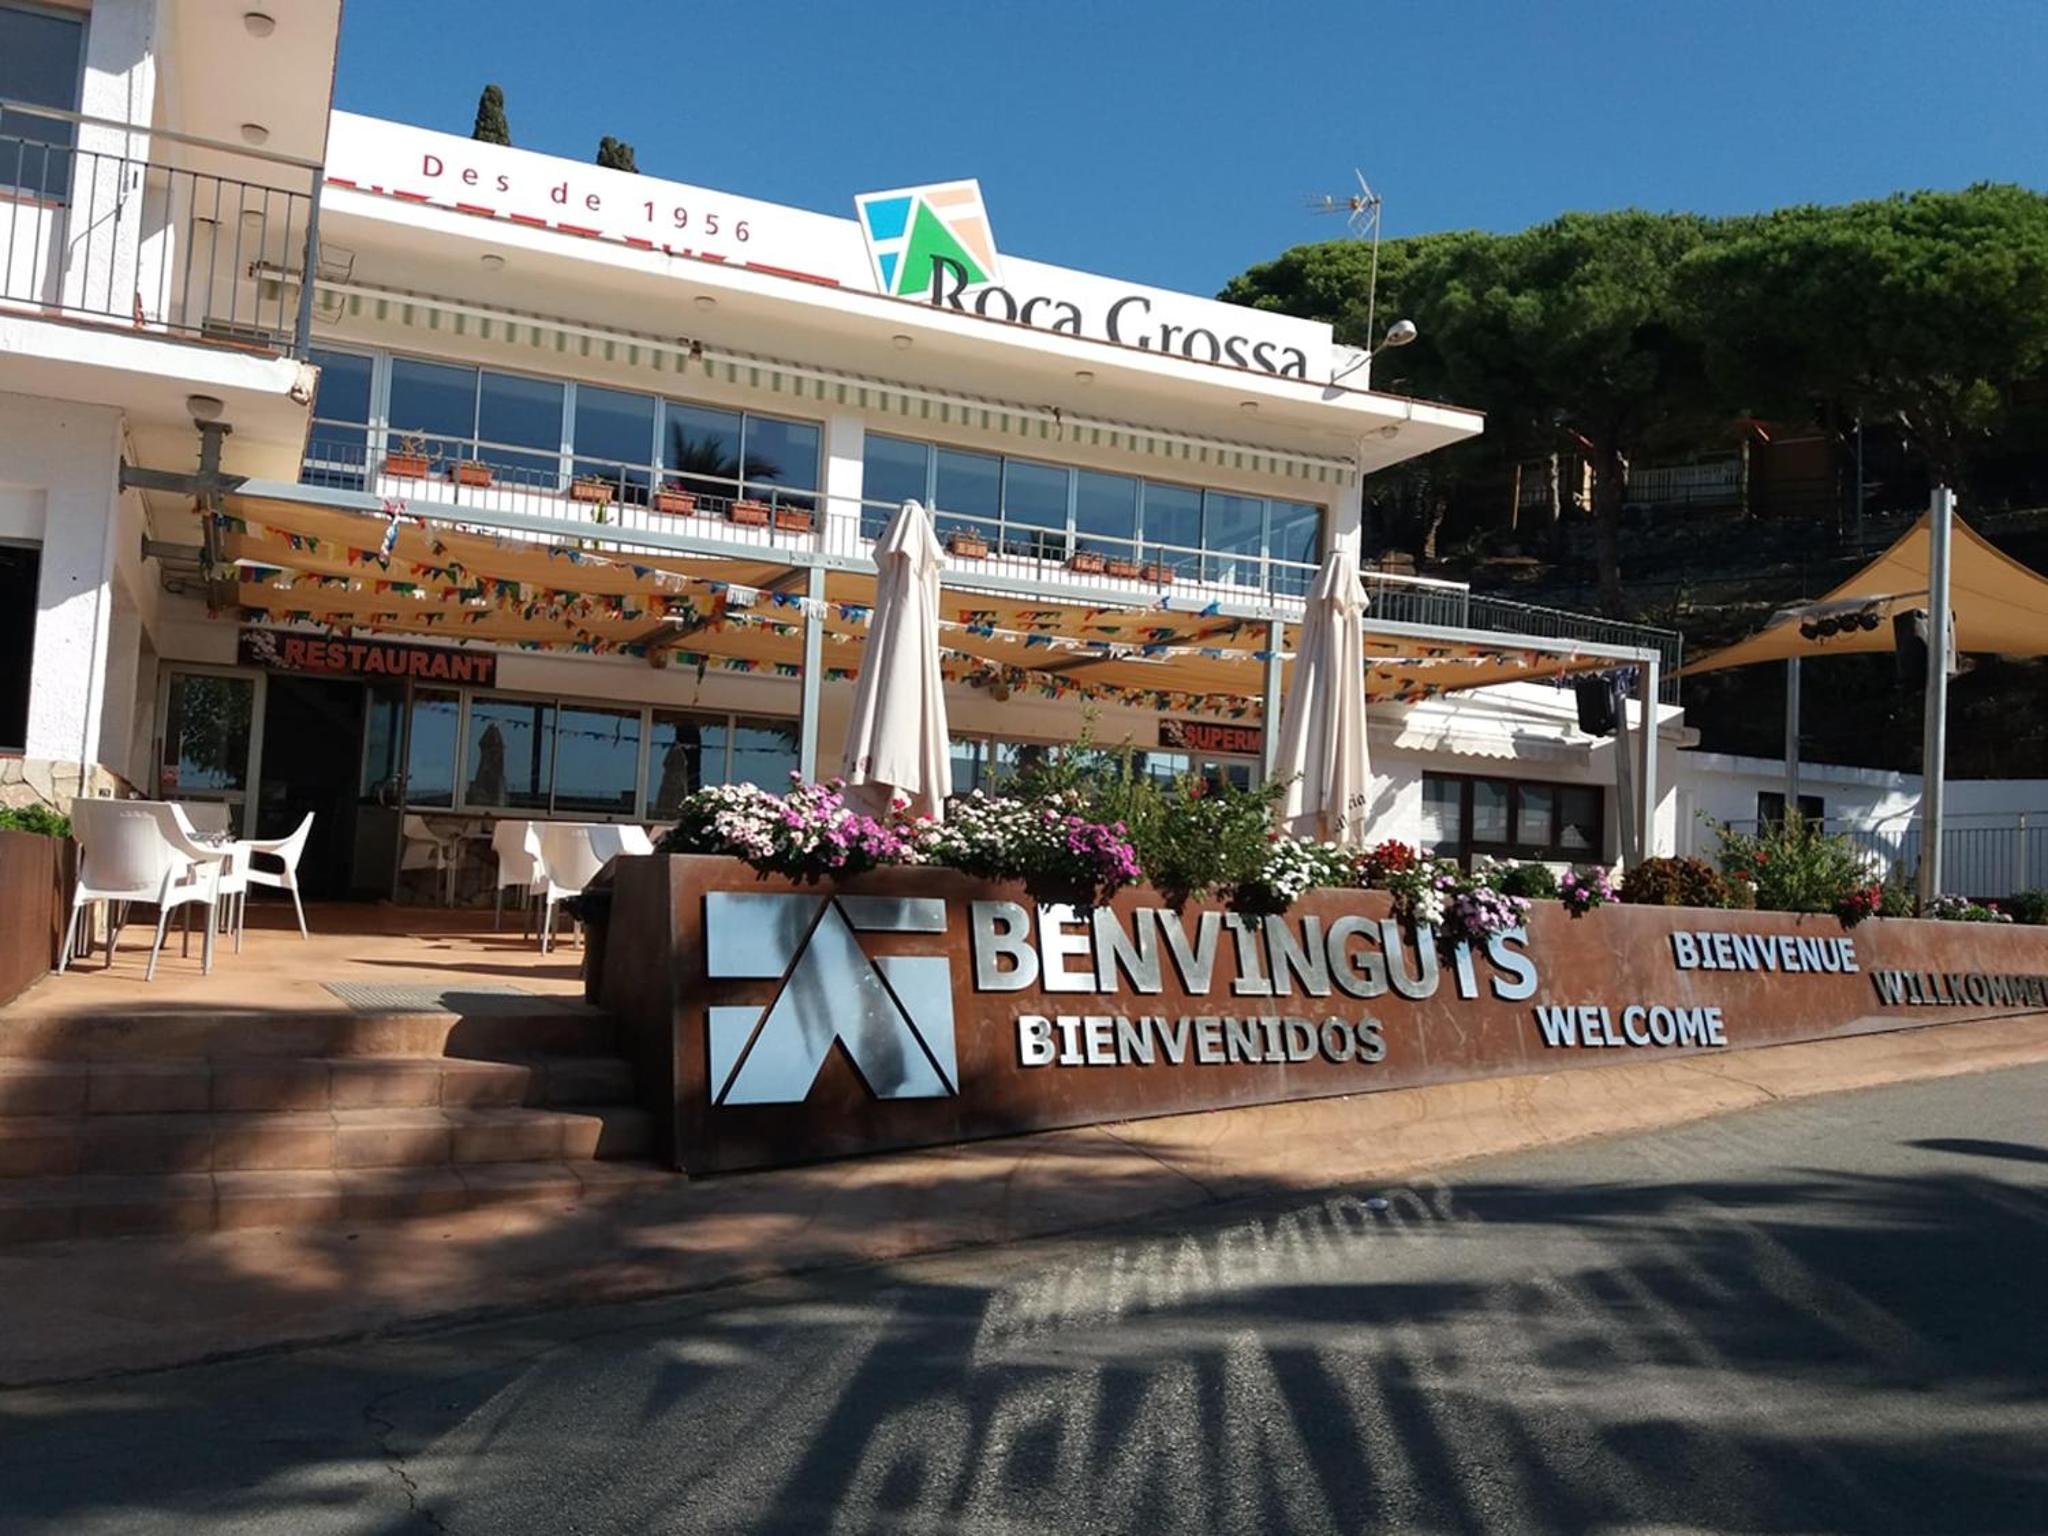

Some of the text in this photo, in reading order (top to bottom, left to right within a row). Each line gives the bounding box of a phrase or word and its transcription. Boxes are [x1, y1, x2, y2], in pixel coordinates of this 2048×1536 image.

[422, 154, 510, 193] Des
[550, 172, 601, 211] de
[643, 201, 750, 243] 1956
[929, 253, 1307, 379] Roca Grossa
[283, 640, 492, 682] RESTAURANT
[1673, 930, 1860, 973] BIENVENUE
[1018, 1014, 1388, 1066] BIENVENIDOS
[1535, 1004, 1728, 1048] WELCOME
